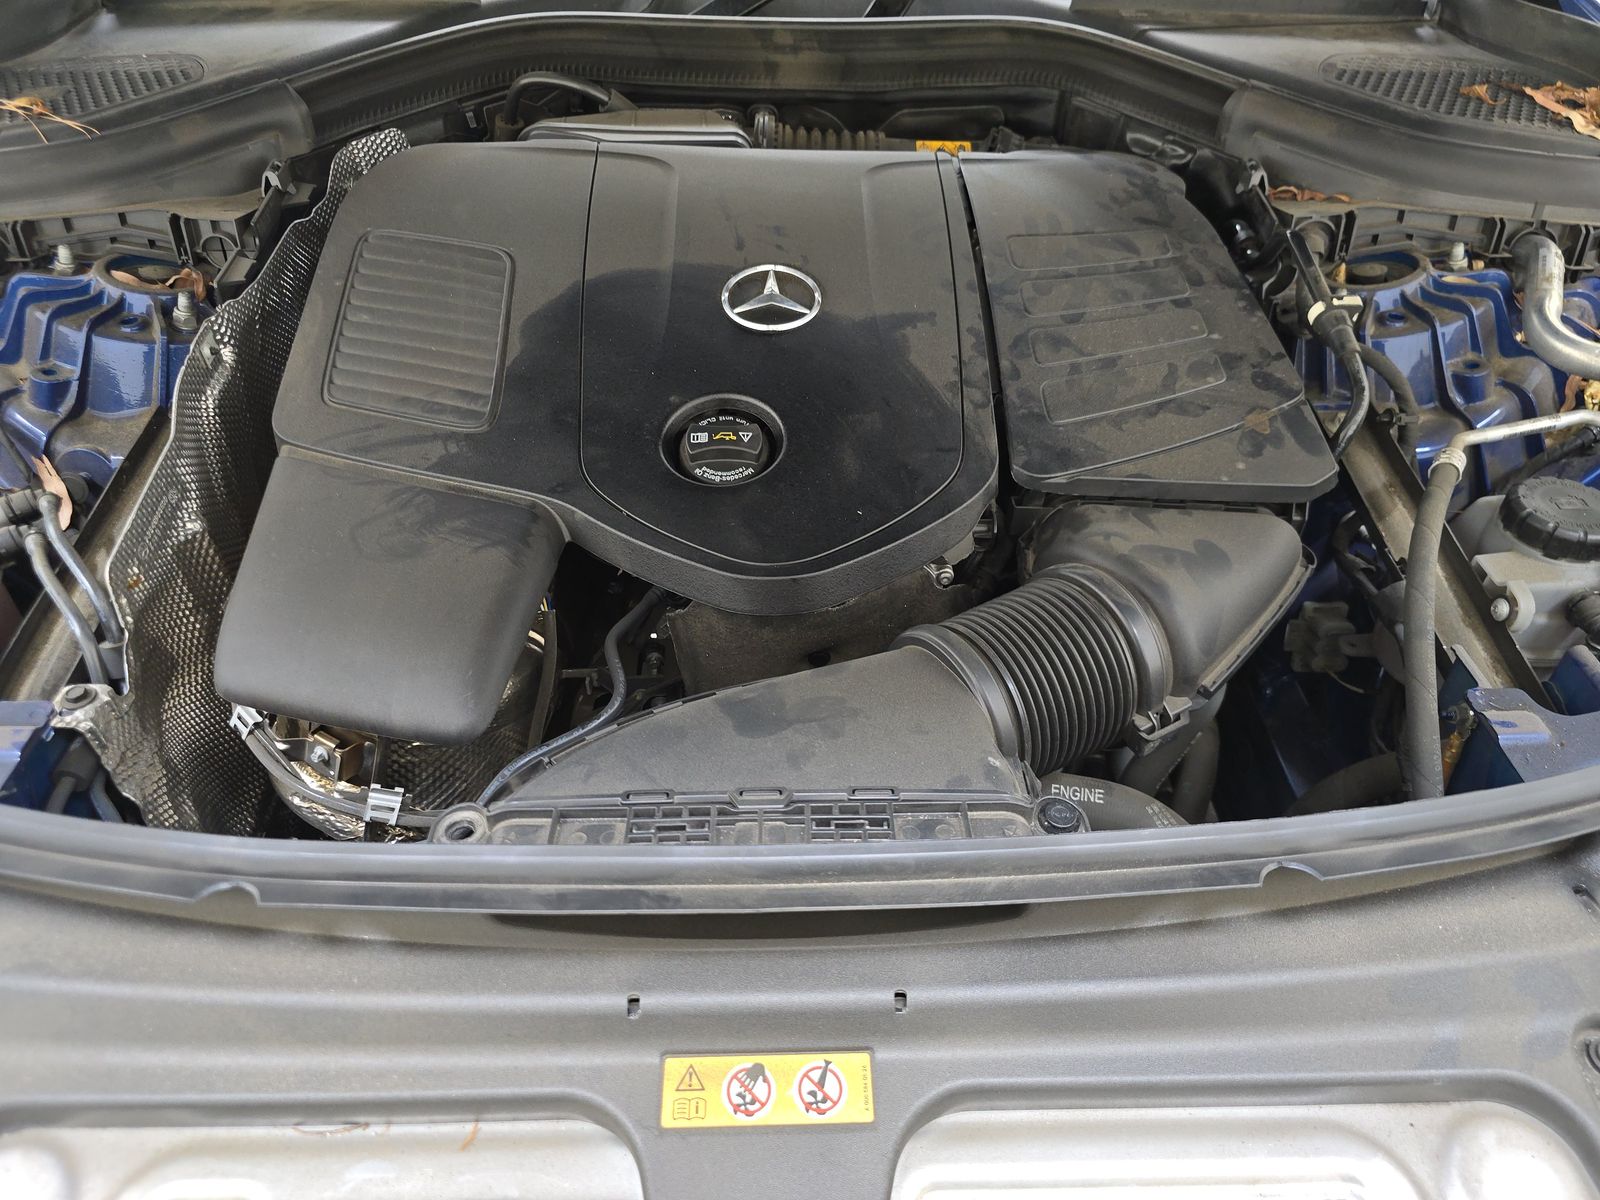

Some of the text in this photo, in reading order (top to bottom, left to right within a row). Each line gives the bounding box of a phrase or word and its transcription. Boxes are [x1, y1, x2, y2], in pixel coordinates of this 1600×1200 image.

[702, 466, 746, 475] recommended
[703, 467, 755, 482] Mercedes-Benz
[1051, 784, 1104, 804] ENGINE
